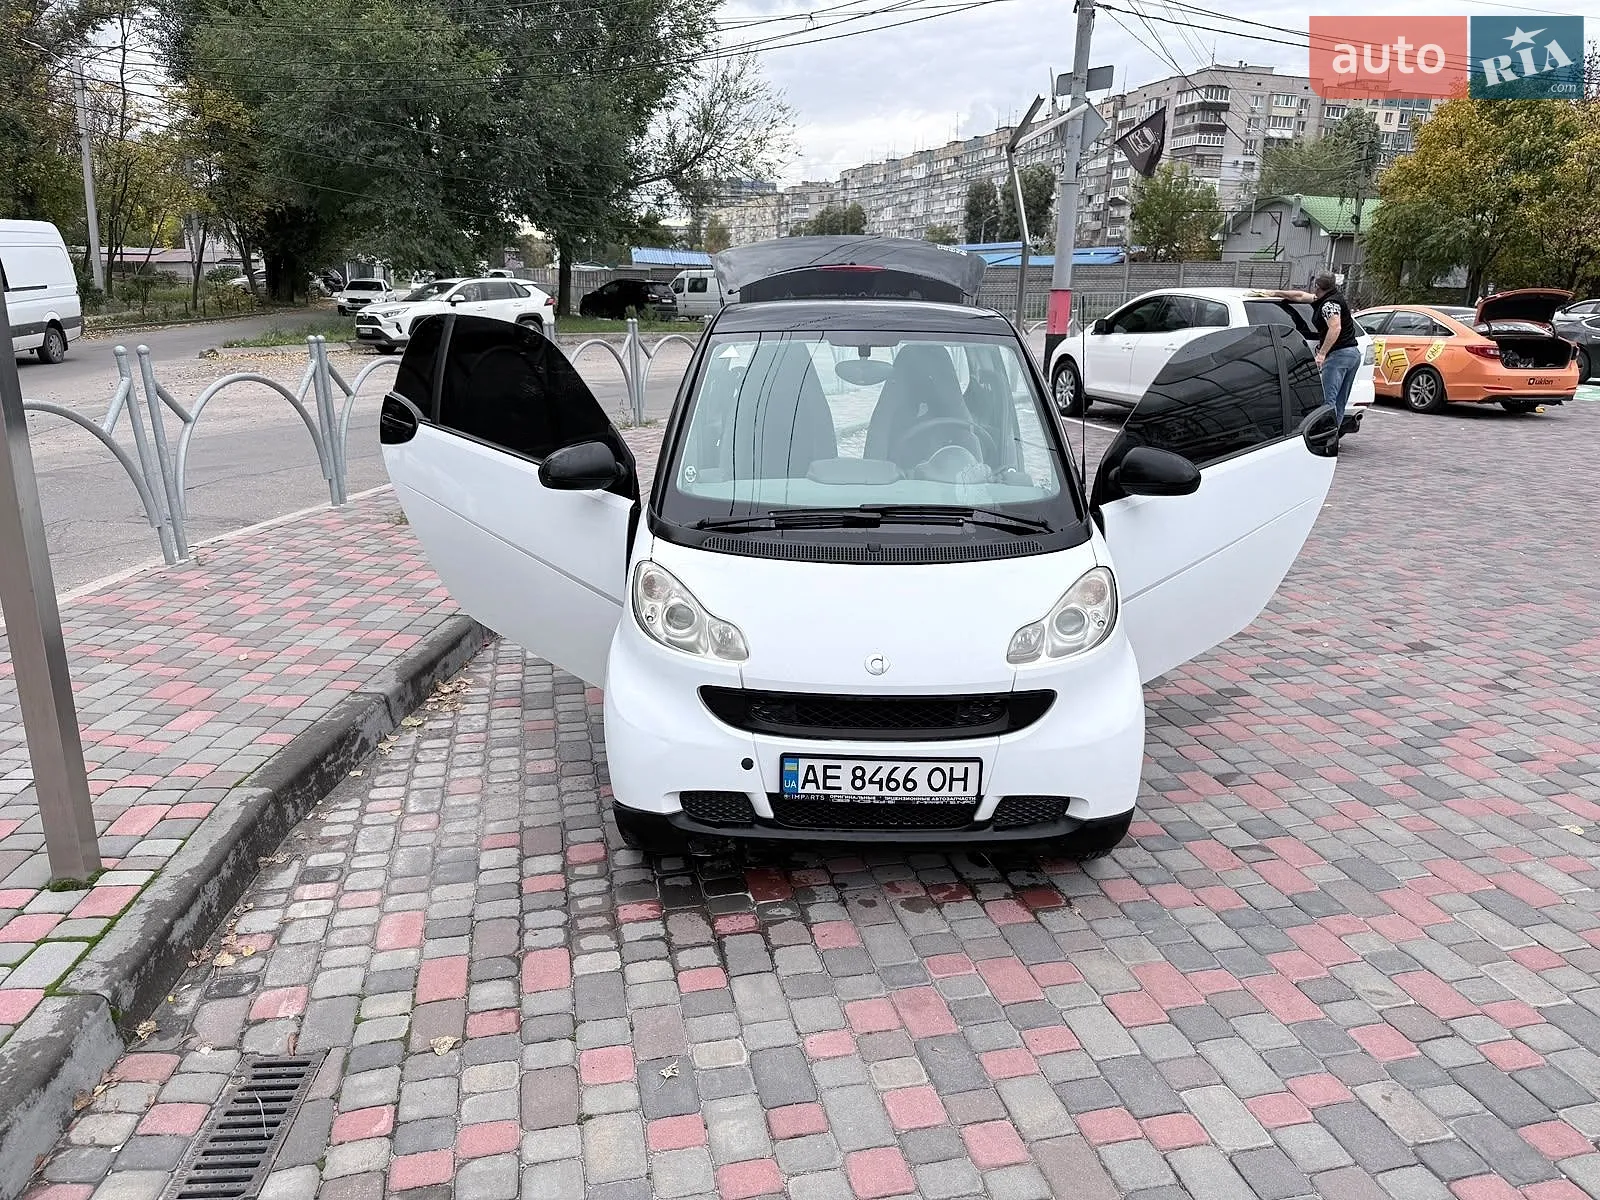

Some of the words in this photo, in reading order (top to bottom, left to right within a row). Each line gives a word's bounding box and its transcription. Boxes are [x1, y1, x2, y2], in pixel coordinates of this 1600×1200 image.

[784, 780, 797, 789] UA
[800, 764, 843, 791] AE
[850, 765, 918, 792] 8466
[927, 766, 969, 792] OH
